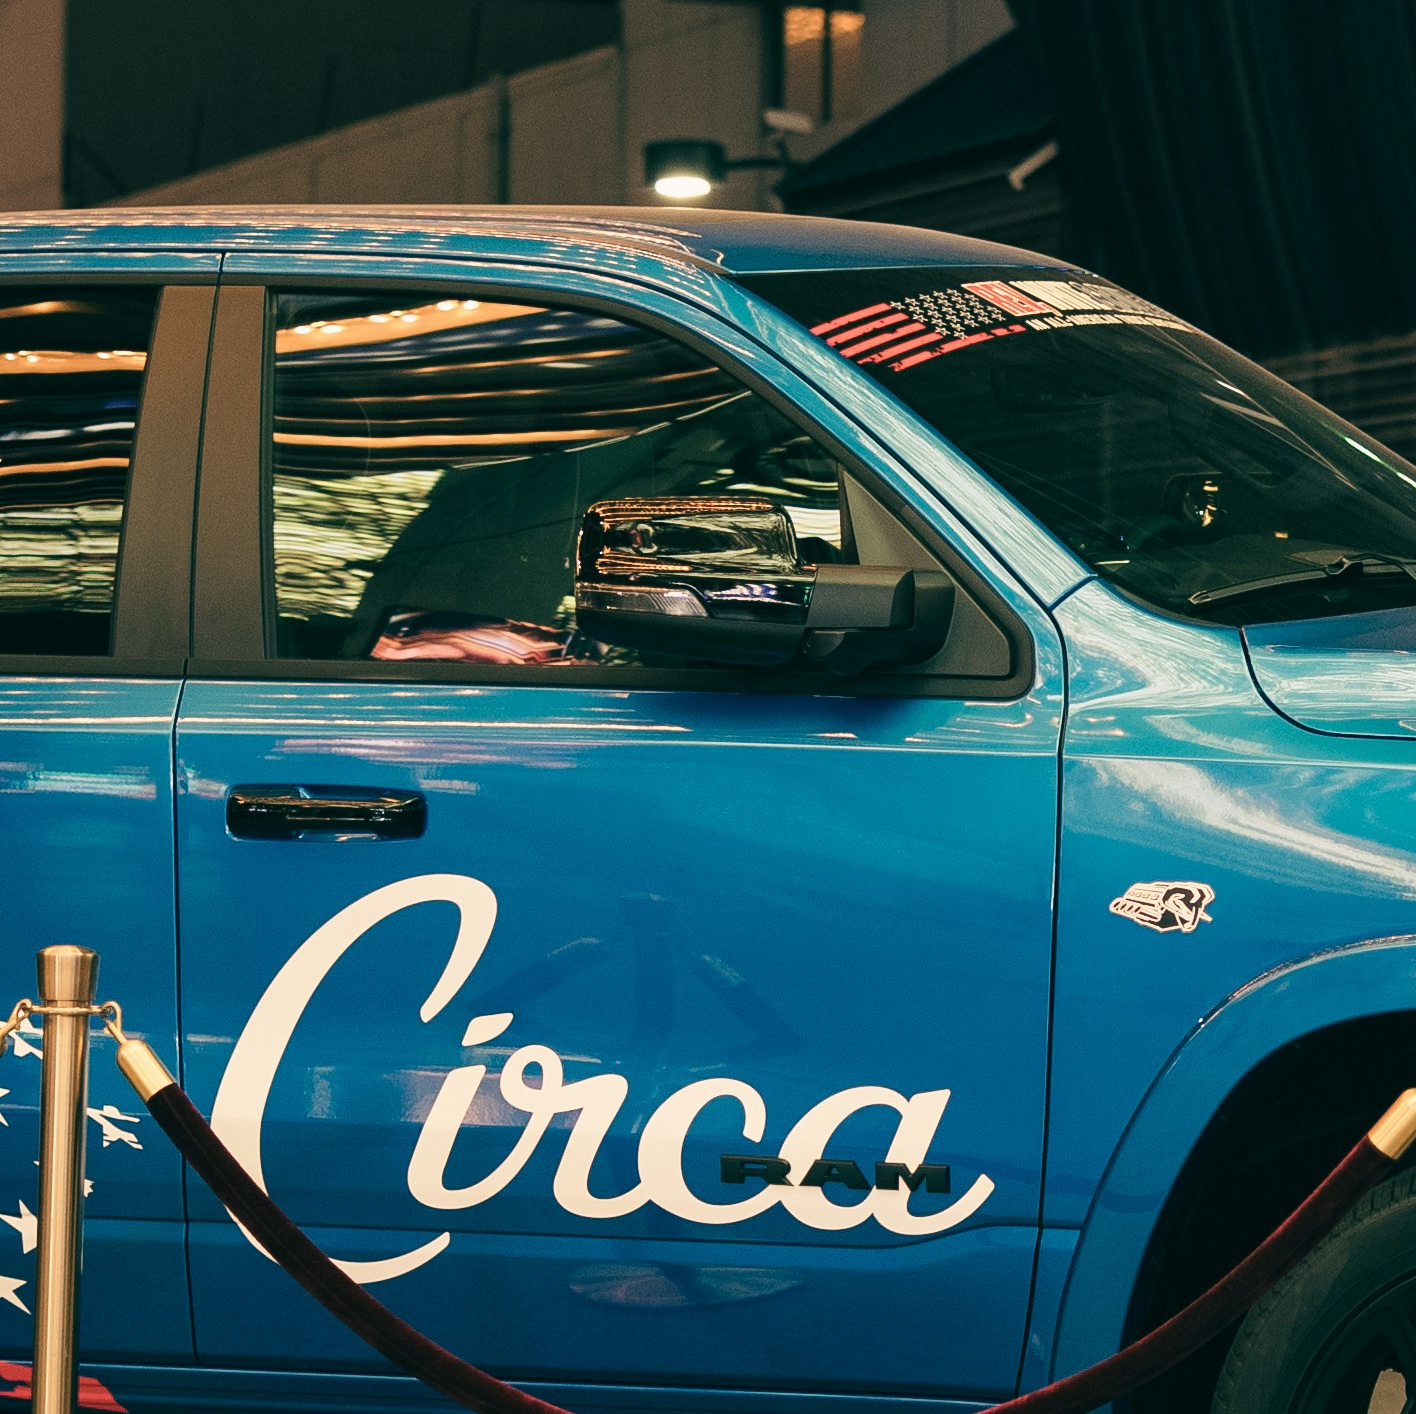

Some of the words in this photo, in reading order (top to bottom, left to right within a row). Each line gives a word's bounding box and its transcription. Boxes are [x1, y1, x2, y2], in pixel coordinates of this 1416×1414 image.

[1008, 280, 1114, 311] WHITE
[210, 873, 995, 1284] Circa
[719, 1153, 952, 1195] RAM
